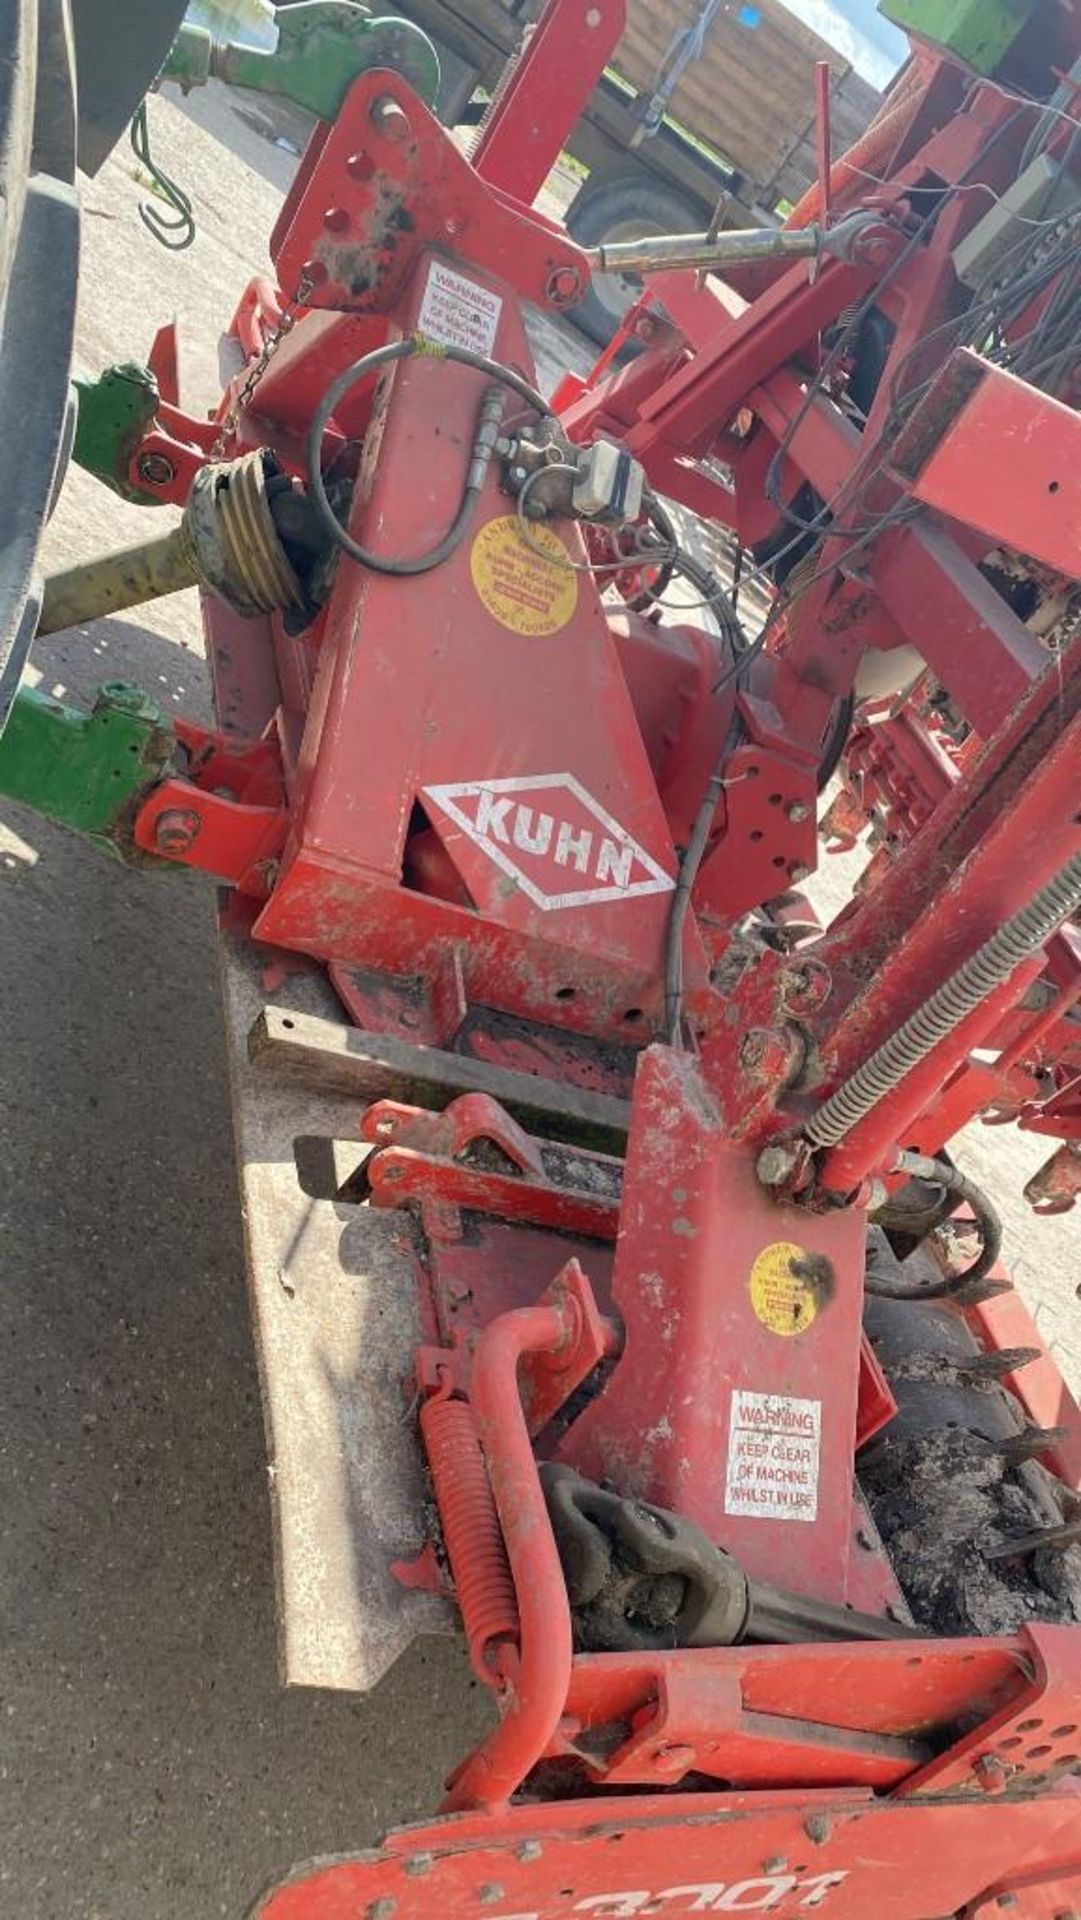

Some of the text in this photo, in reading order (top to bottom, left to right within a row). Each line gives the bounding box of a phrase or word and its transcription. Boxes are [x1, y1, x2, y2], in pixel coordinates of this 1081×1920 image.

[434, 271, 495, 313] WARNING
[474, 789, 635, 889] KUHN
[739, 1406, 814, 1430] WARNING
[737, 1443, 810, 1462] KEEP CLEAR
[738, 1464, 808, 1484] OF MACHINE
[731, 1487, 812, 1507] WHILST IN USE
